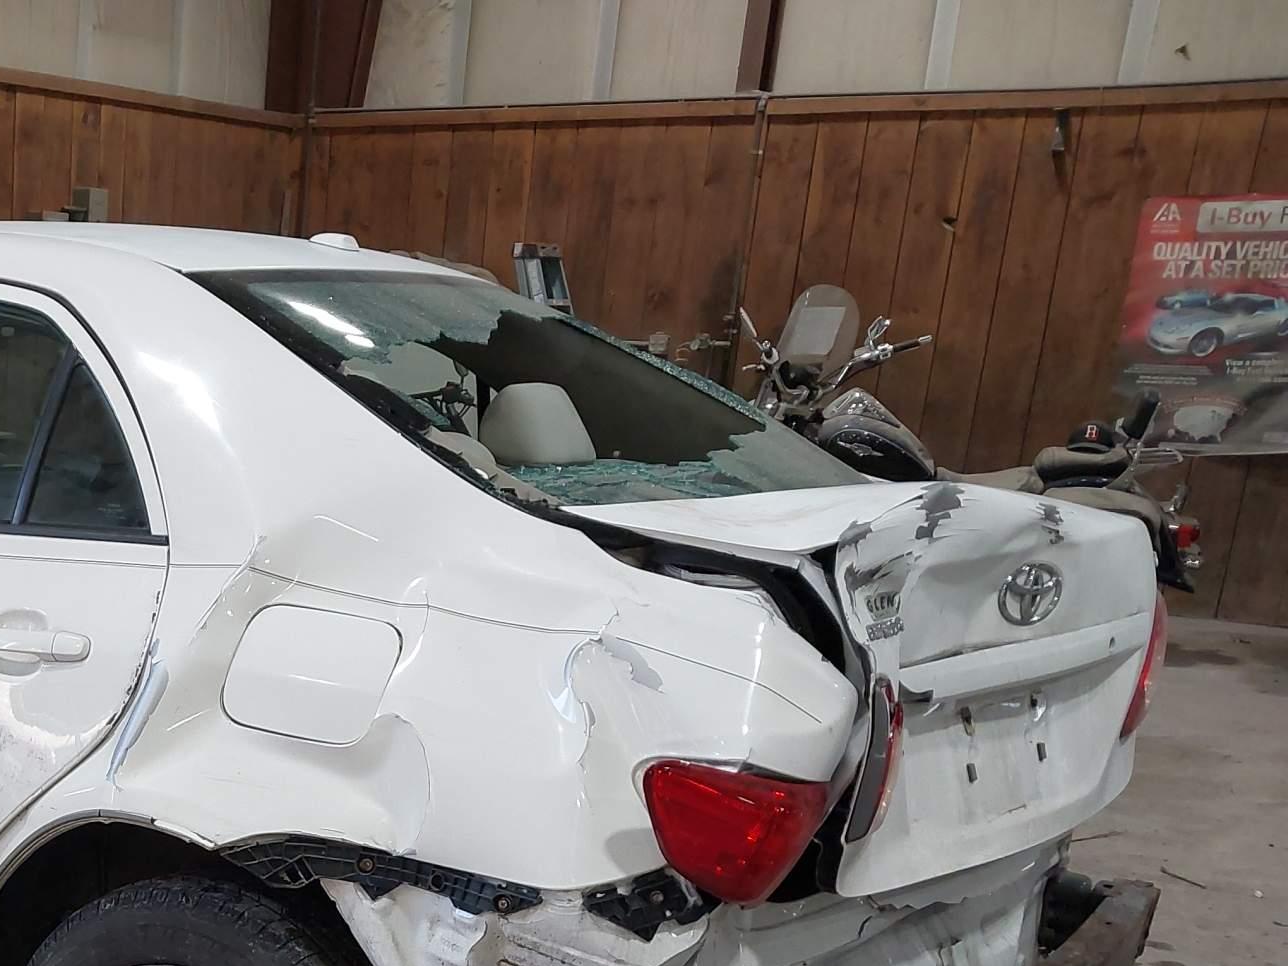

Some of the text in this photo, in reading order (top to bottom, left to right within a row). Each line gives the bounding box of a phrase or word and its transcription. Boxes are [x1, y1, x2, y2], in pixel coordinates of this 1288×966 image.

[1210, 206, 1273, 228] I-Buy
[1153, 241, 1233, 260] QUALITY
[1161, 260, 1190, 279] AT
[1189, 260, 1205, 279] A
[1207, 260, 1246, 279] SET
